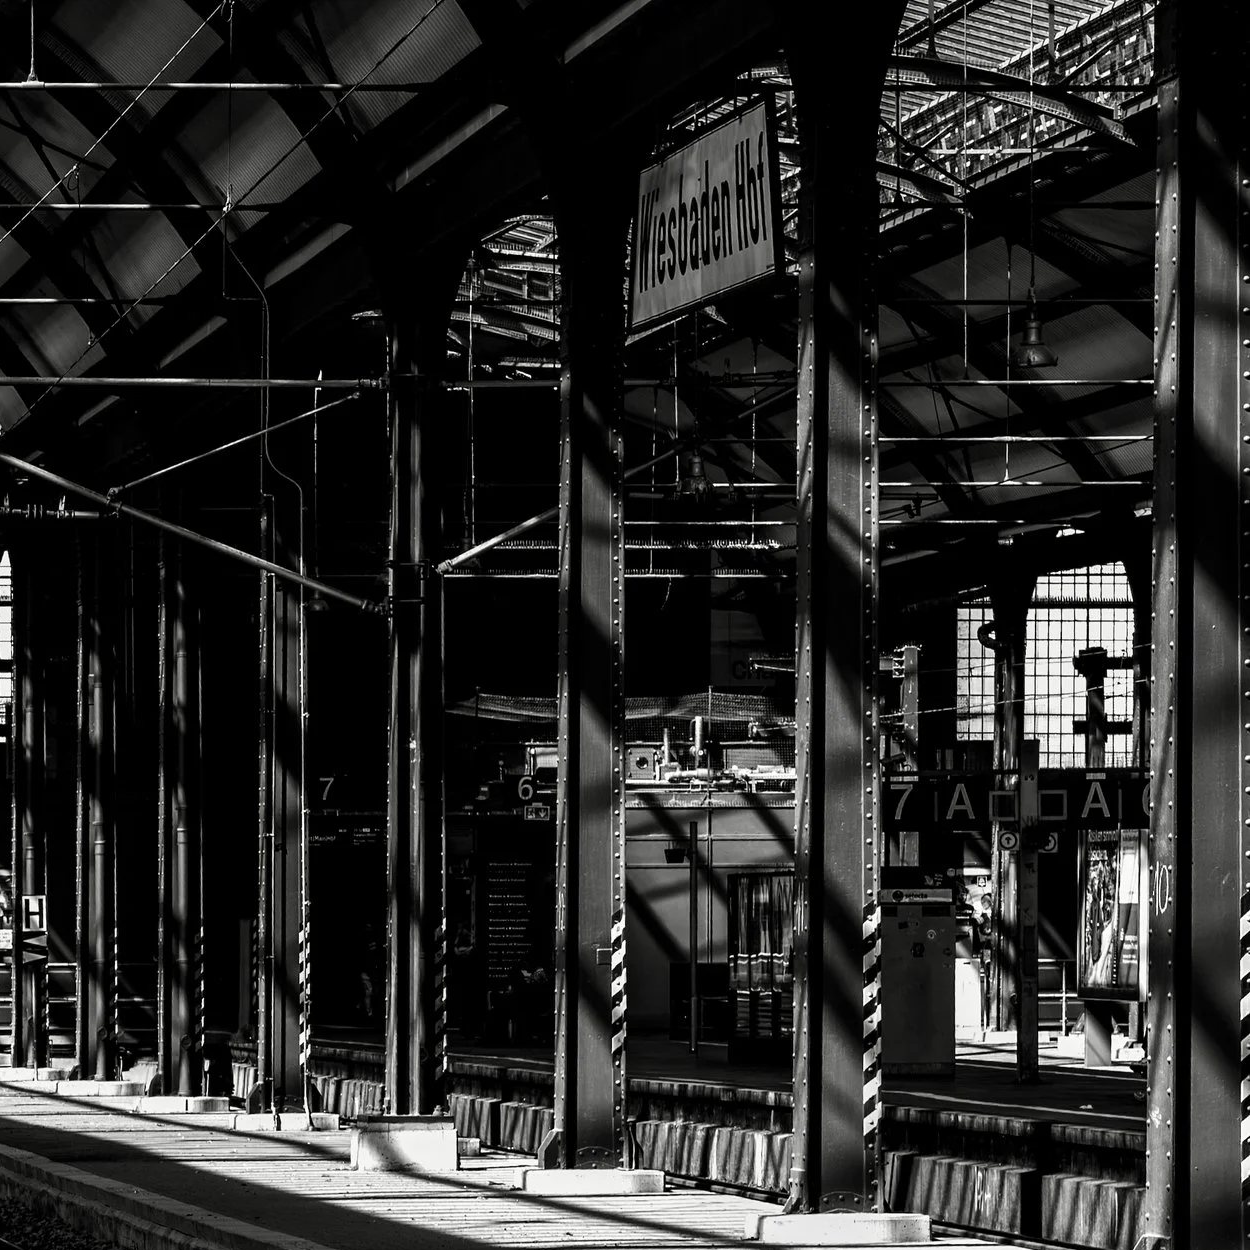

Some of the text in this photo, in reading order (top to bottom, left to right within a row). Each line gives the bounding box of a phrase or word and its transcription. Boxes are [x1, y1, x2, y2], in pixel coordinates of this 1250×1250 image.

[639, 131, 767, 293] Wiesbaden Hbf
[319, 777, 334, 800] 7
[518, 776, 533, 800] 6
[890, 783, 976, 820] 7 A
[1081, 781, 1111, 818] A
[25, 899, 43, 928] H
